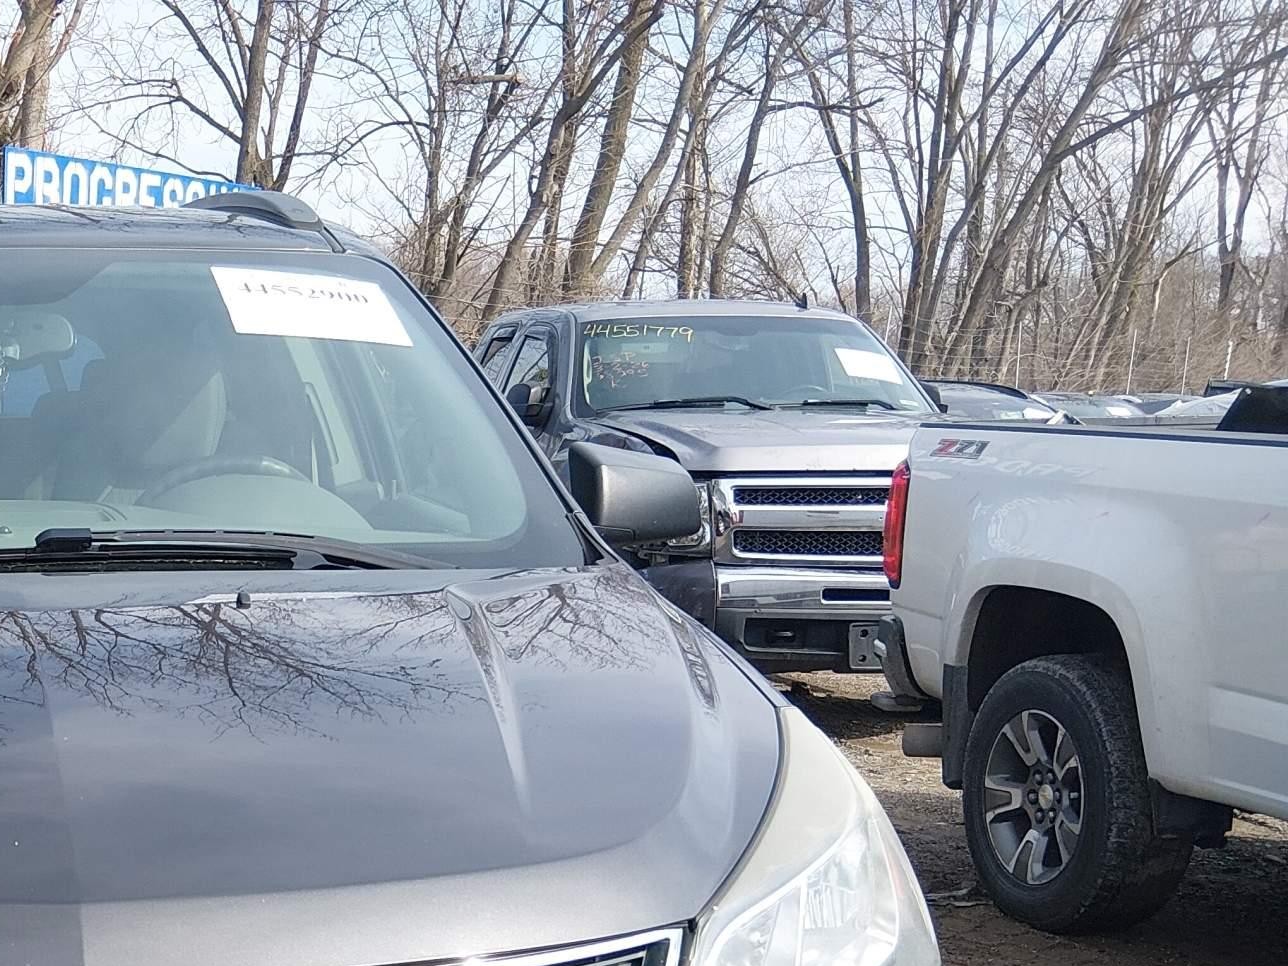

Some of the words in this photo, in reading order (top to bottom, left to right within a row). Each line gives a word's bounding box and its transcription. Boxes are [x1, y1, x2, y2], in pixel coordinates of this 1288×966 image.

[239, 282, 369, 304] 44552900
[583, 324, 694, 343] 44551779
[930, 438, 991, 460] Z71
